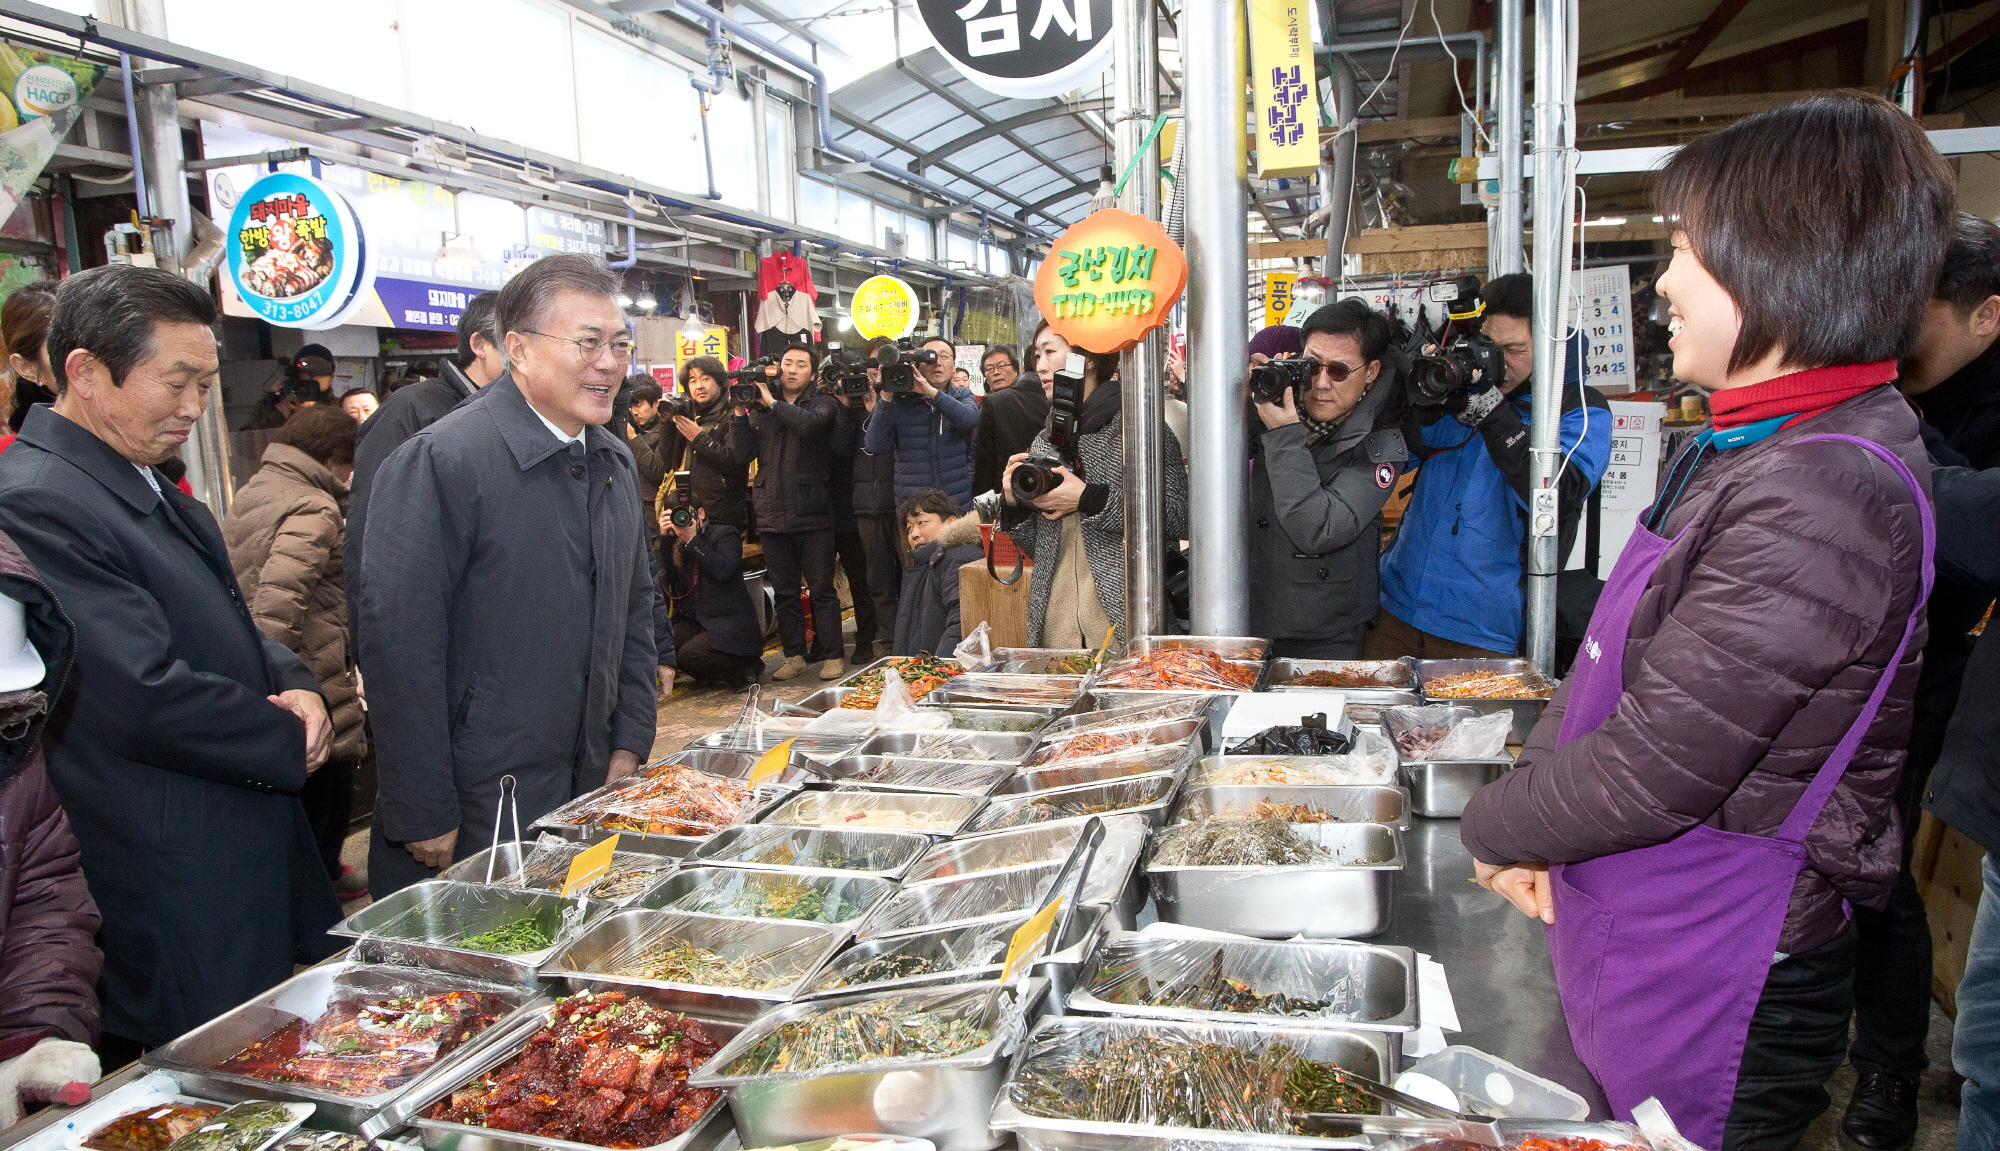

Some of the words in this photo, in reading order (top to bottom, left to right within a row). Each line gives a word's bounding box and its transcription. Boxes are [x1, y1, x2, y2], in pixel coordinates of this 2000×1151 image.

[1287, 7, 1300, 58] 도시락뷔페
[26, 87, 71, 104] HACCP
[249, 193, 310, 222] 돼지마을
[239, 224, 270, 251] 한방
[271, 222, 293, 250] 왕
[295, 214, 328, 241] 족발
[1058, 244, 1157, 287] 군산김치
[262, 292, 324, 320] 313-8047
[427, 289, 466, 309] 돼지마을
[1051, 288, 1155, 319] T313-4493
[1375, 294, 1404, 304] 2017
[404, 309, 428, 325] 체인점
[428, 311, 443, 325] 문의
[1594, 308, 1602, 317] 3
[1612, 305, 1619, 315] 4
[1593, 327, 1605, 336] 10
[1611, 325, 1623, 334] 11
[681, 336, 698, 361] 감
[703, 335, 720, 359] 순
[1594, 345, 1606, 355] 17
[1611, 344, 1624, 353] 18
[1594, 364, 1608, 374] 24
[1611, 362, 1625, 373] 25
[1727, 435, 1745, 443] SONY
[1614, 454, 1626, 462] EA
